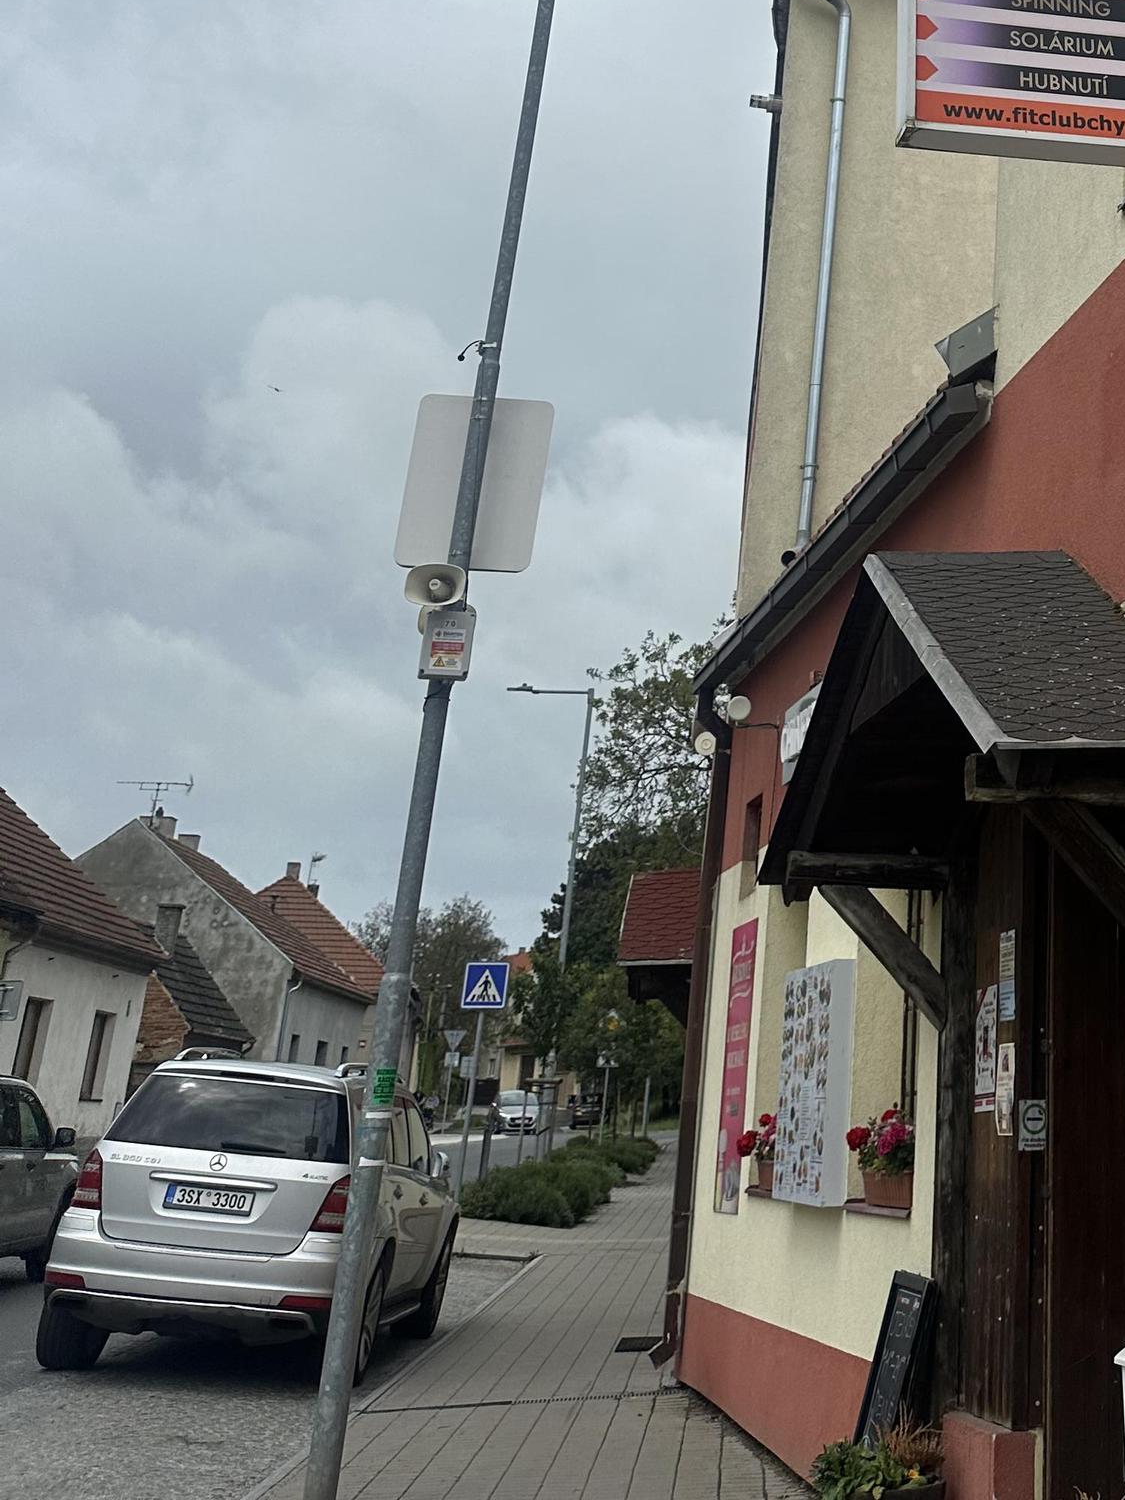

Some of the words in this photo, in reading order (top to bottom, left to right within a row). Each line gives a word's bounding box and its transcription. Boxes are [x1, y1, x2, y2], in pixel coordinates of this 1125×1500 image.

[1010, 30, 1115, 57] SOLÁRIUM
[1019, 71, 1108, 95] HUBNUTÍ
[177, 1188, 204, 1205] 3SX
[212, 1192, 246, 1209] 3300
